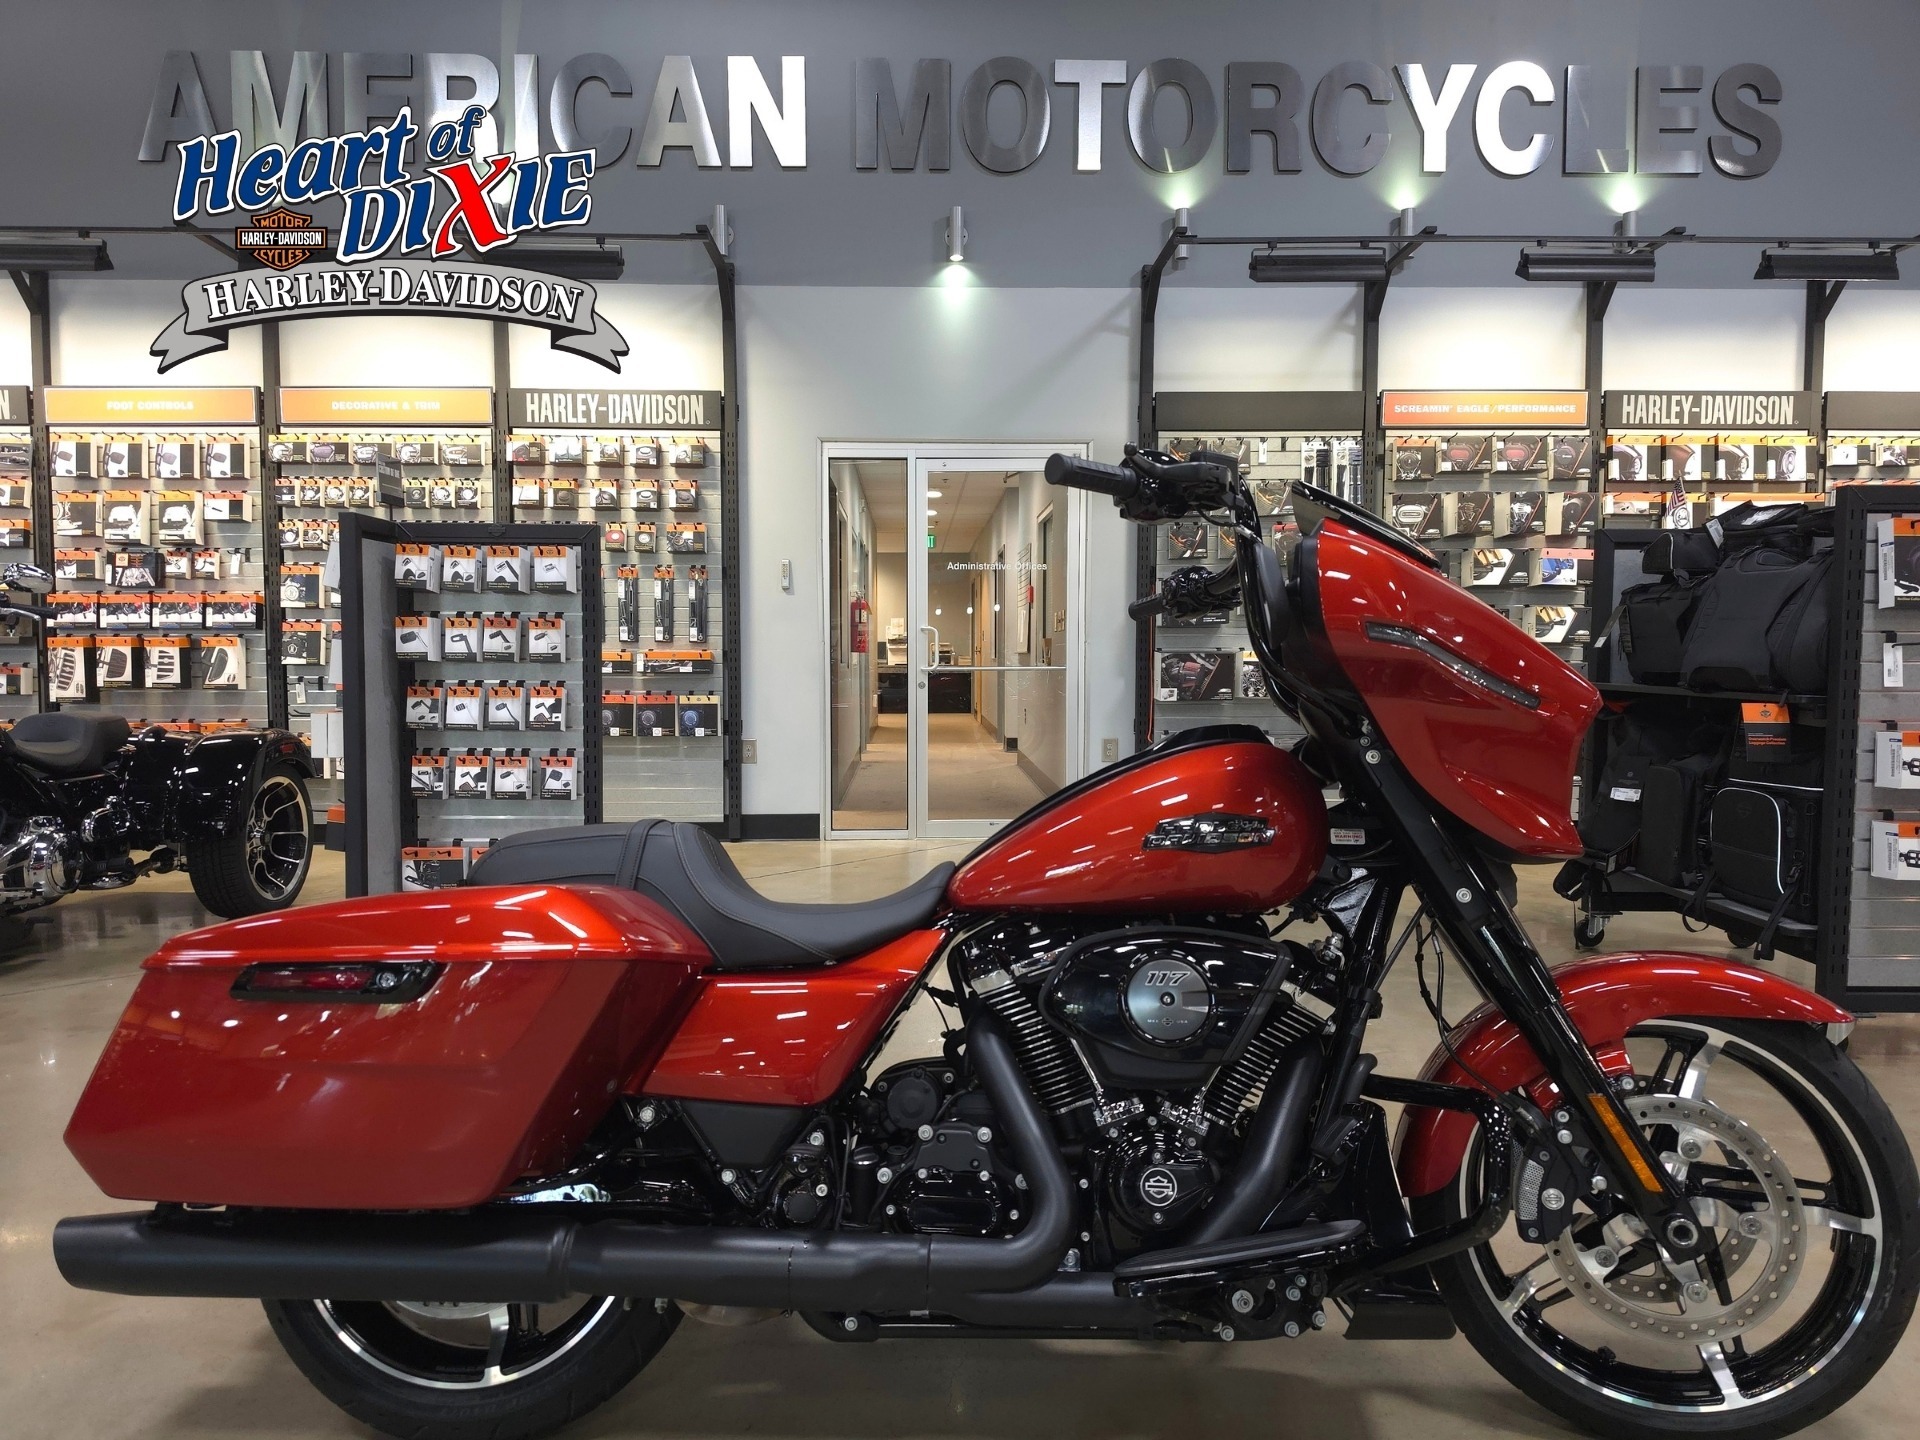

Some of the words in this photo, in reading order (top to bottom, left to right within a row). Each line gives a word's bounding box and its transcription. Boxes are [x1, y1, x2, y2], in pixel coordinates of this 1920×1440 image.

[853, 56, 1784, 178] MOTORCYCLES
[106, 401, 134, 411] FOOT
[137, 401, 194, 411] CONTROLS
[331, 401, 399, 411] DECORATIVE
[414, 401, 441, 411] TRIM
[525, 391, 705, 426] HARLEY-DAVIDSON
[1394, 404, 1454, 414] SCREAMIN'
[1622, 394, 1795, 426] HARLEY-DAVIDSON
[947, 562, 1012, 570] Administrative
[1014, 562, 1048, 570] Offices
[1145, 971, 1190, 986] 117
